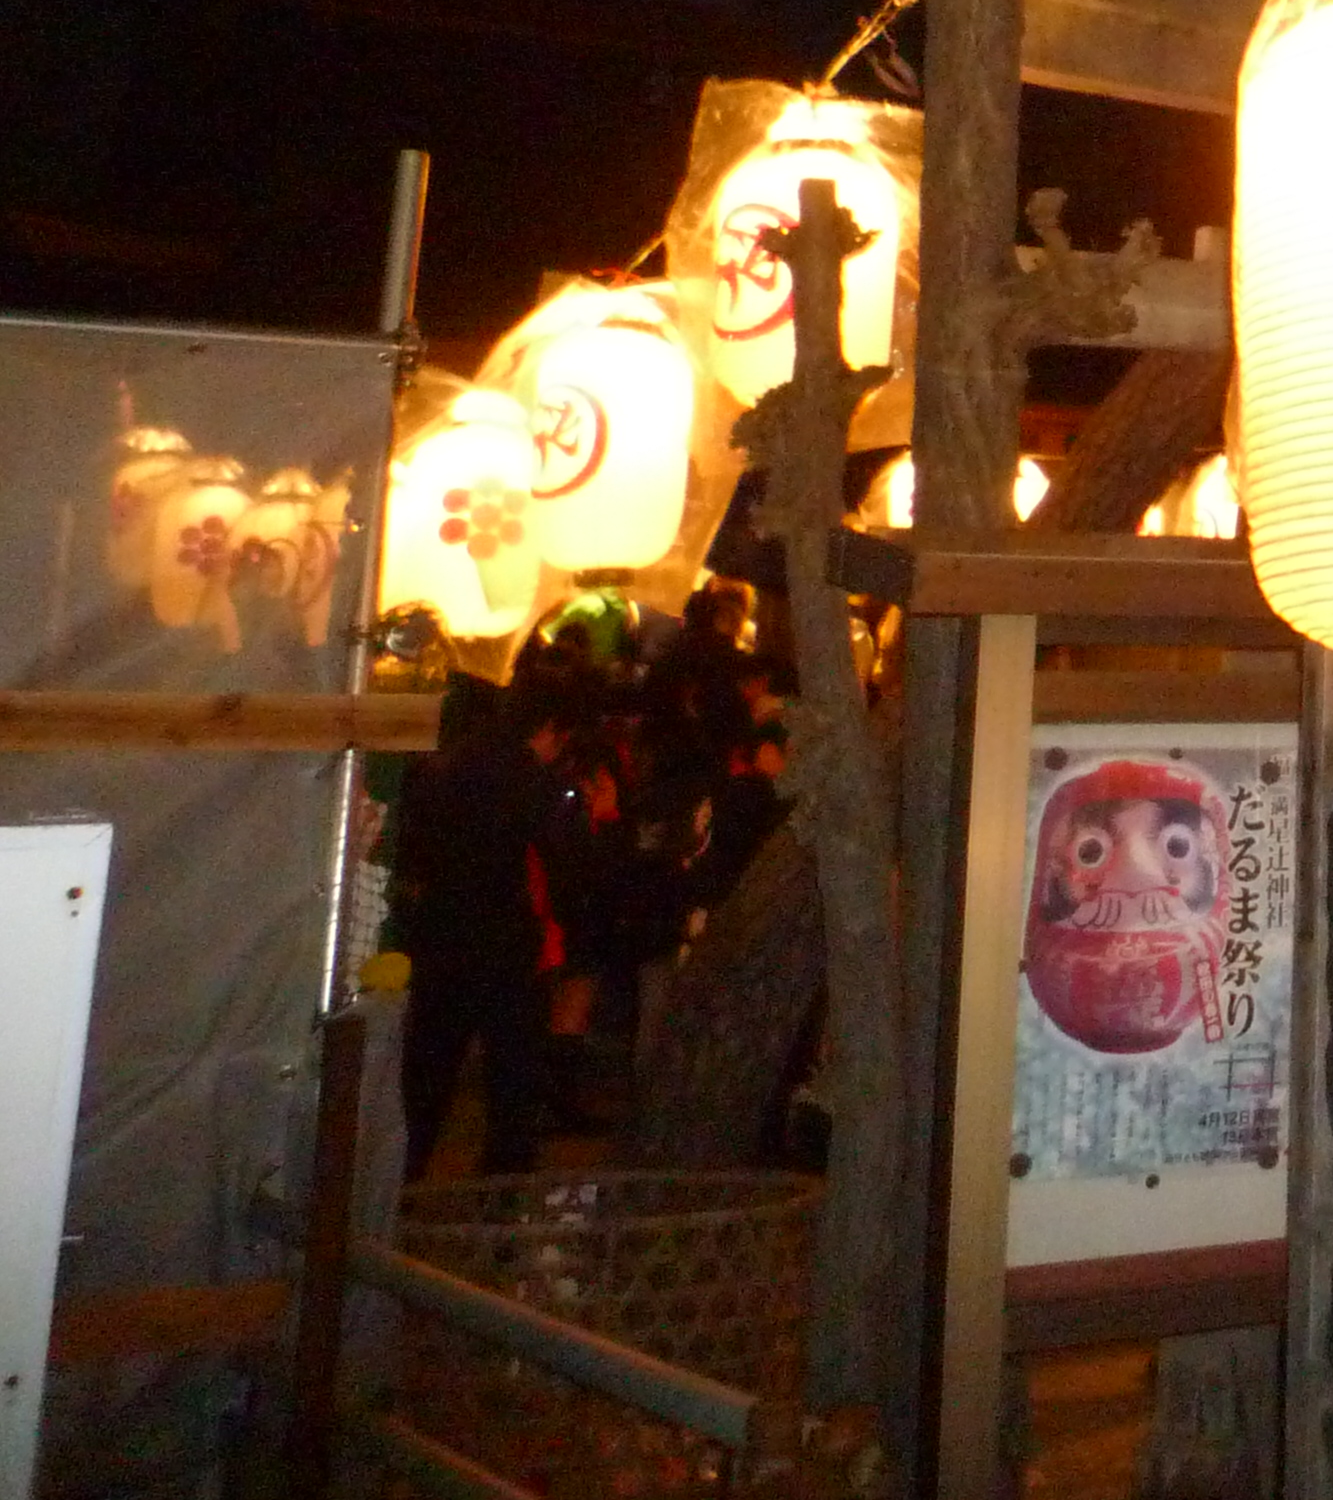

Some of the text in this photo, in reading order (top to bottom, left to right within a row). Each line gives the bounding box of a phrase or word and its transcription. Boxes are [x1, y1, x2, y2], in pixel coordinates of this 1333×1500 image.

[1222, 784, 1266, 1039] だるま祭り
